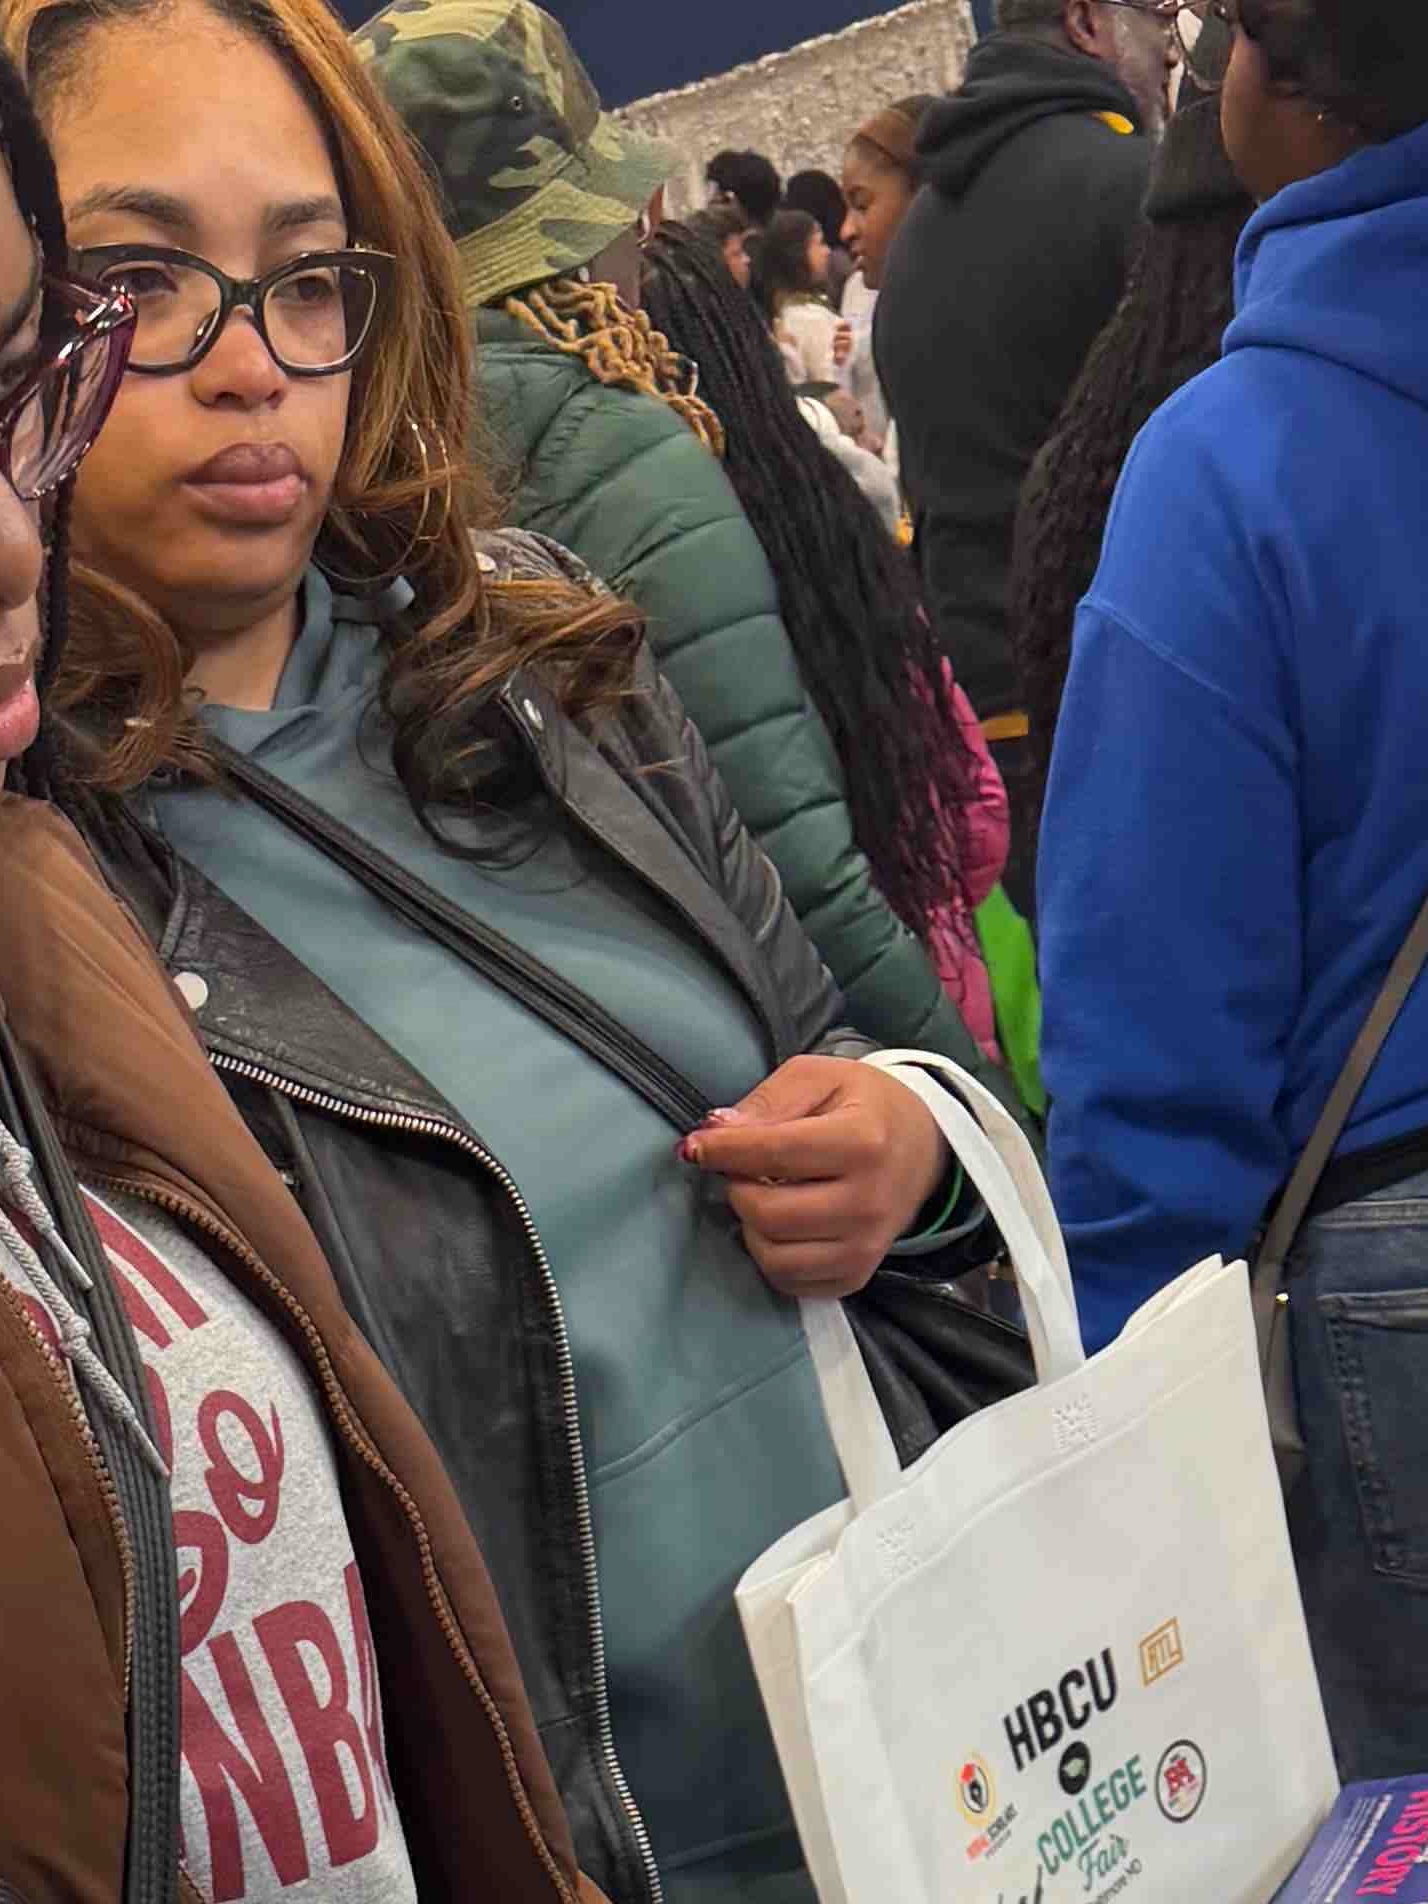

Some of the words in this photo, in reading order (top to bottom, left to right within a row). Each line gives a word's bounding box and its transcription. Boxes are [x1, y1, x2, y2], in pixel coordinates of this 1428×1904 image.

[1004, 1648, 1118, 1772] HBCU
[1037, 1755, 1149, 1876] COLLEGE
[1078, 1835, 1129, 1893] Fair
